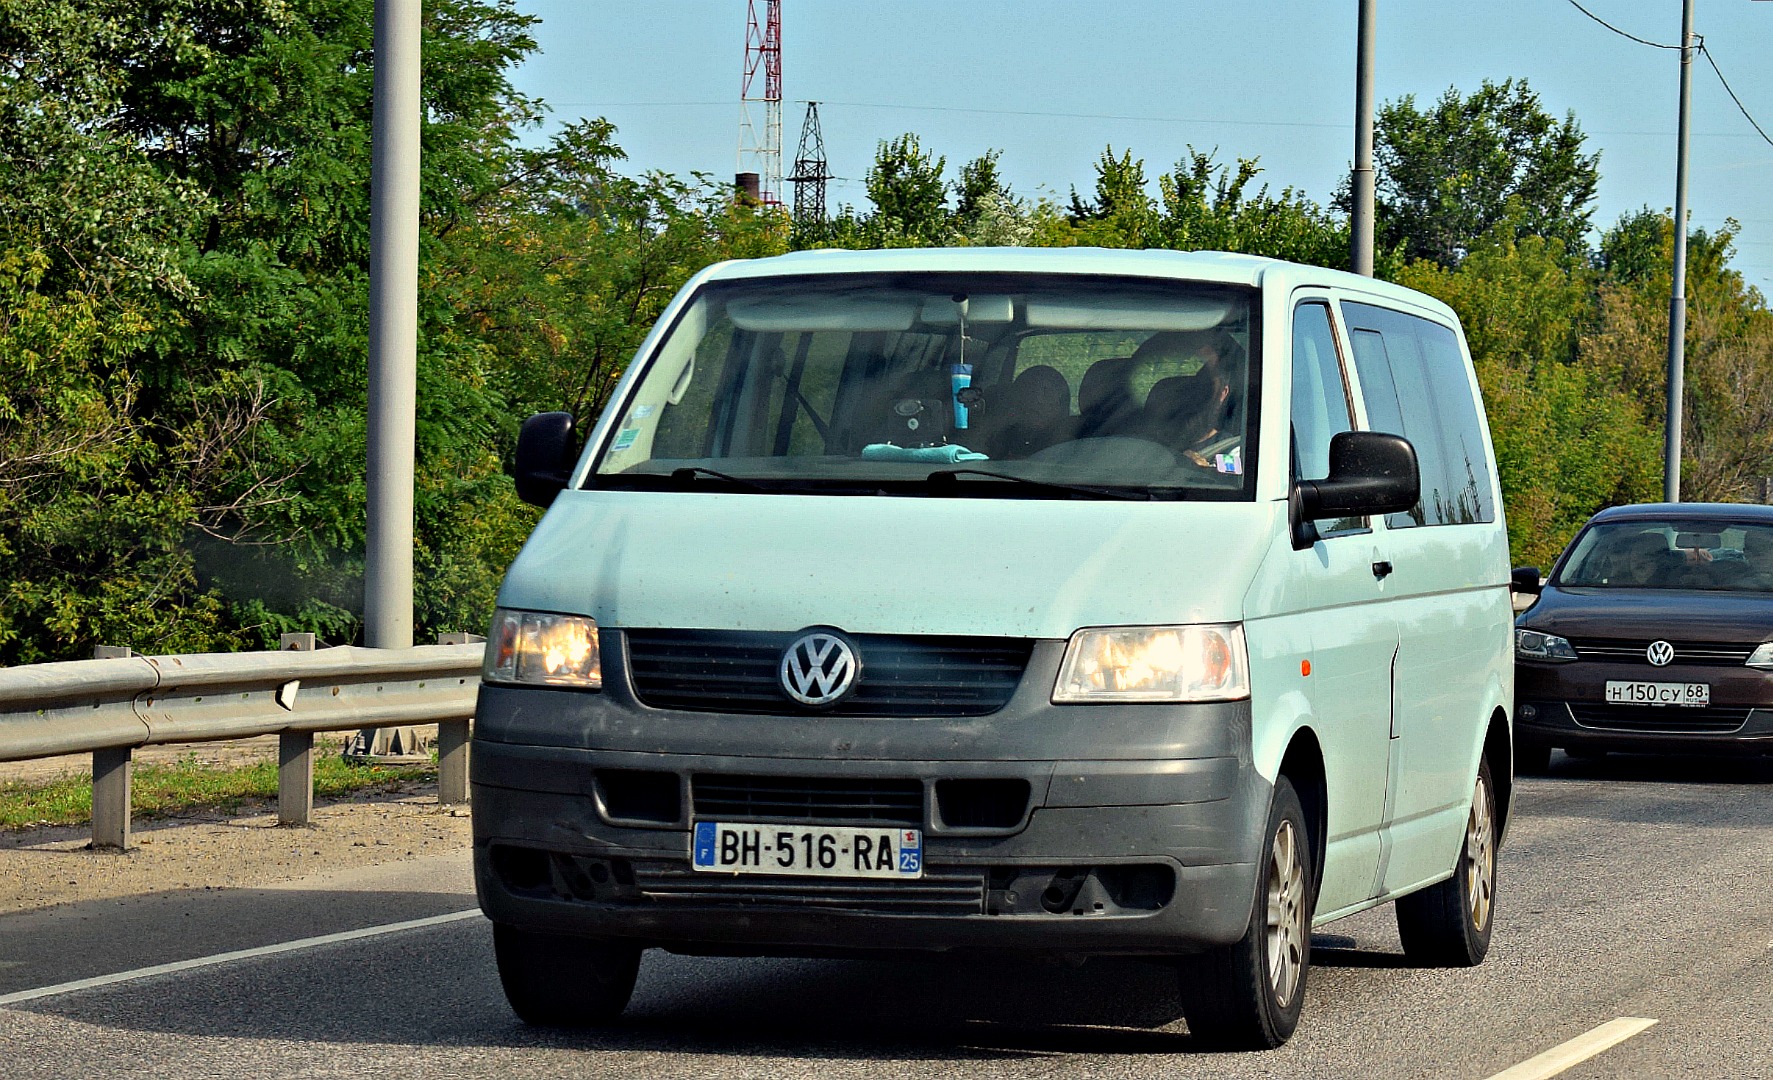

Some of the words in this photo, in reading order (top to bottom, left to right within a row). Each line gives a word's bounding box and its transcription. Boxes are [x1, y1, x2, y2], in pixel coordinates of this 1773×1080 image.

[1686, 685, 1704, 698] 68
[701, 848, 709, 859] F
[720, 829, 895, 871] BH-516-RA
[901, 853, 918, 870] 25
